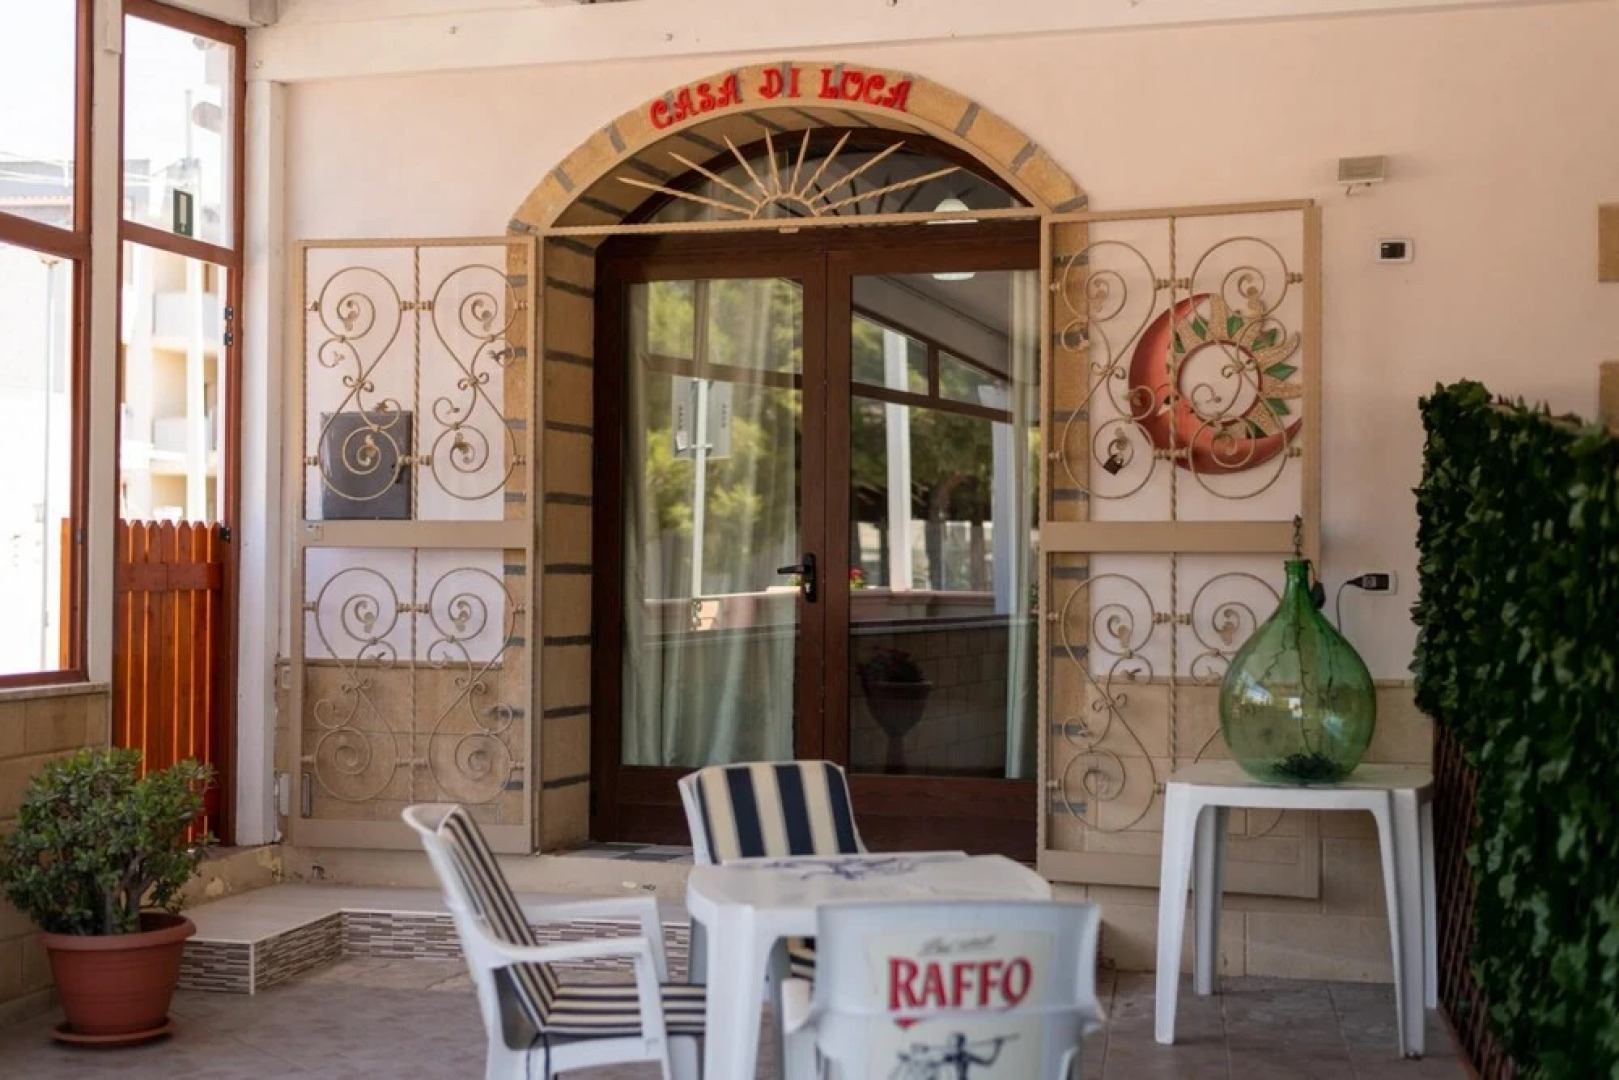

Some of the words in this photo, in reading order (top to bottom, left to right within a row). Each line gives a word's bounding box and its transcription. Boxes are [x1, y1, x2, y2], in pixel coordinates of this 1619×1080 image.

[650, 72, 743, 129] CASA
[759, 68, 801, 99] DI
[818, 68, 912, 112] LUCA
[888, 957, 1032, 1011] RAFFO
